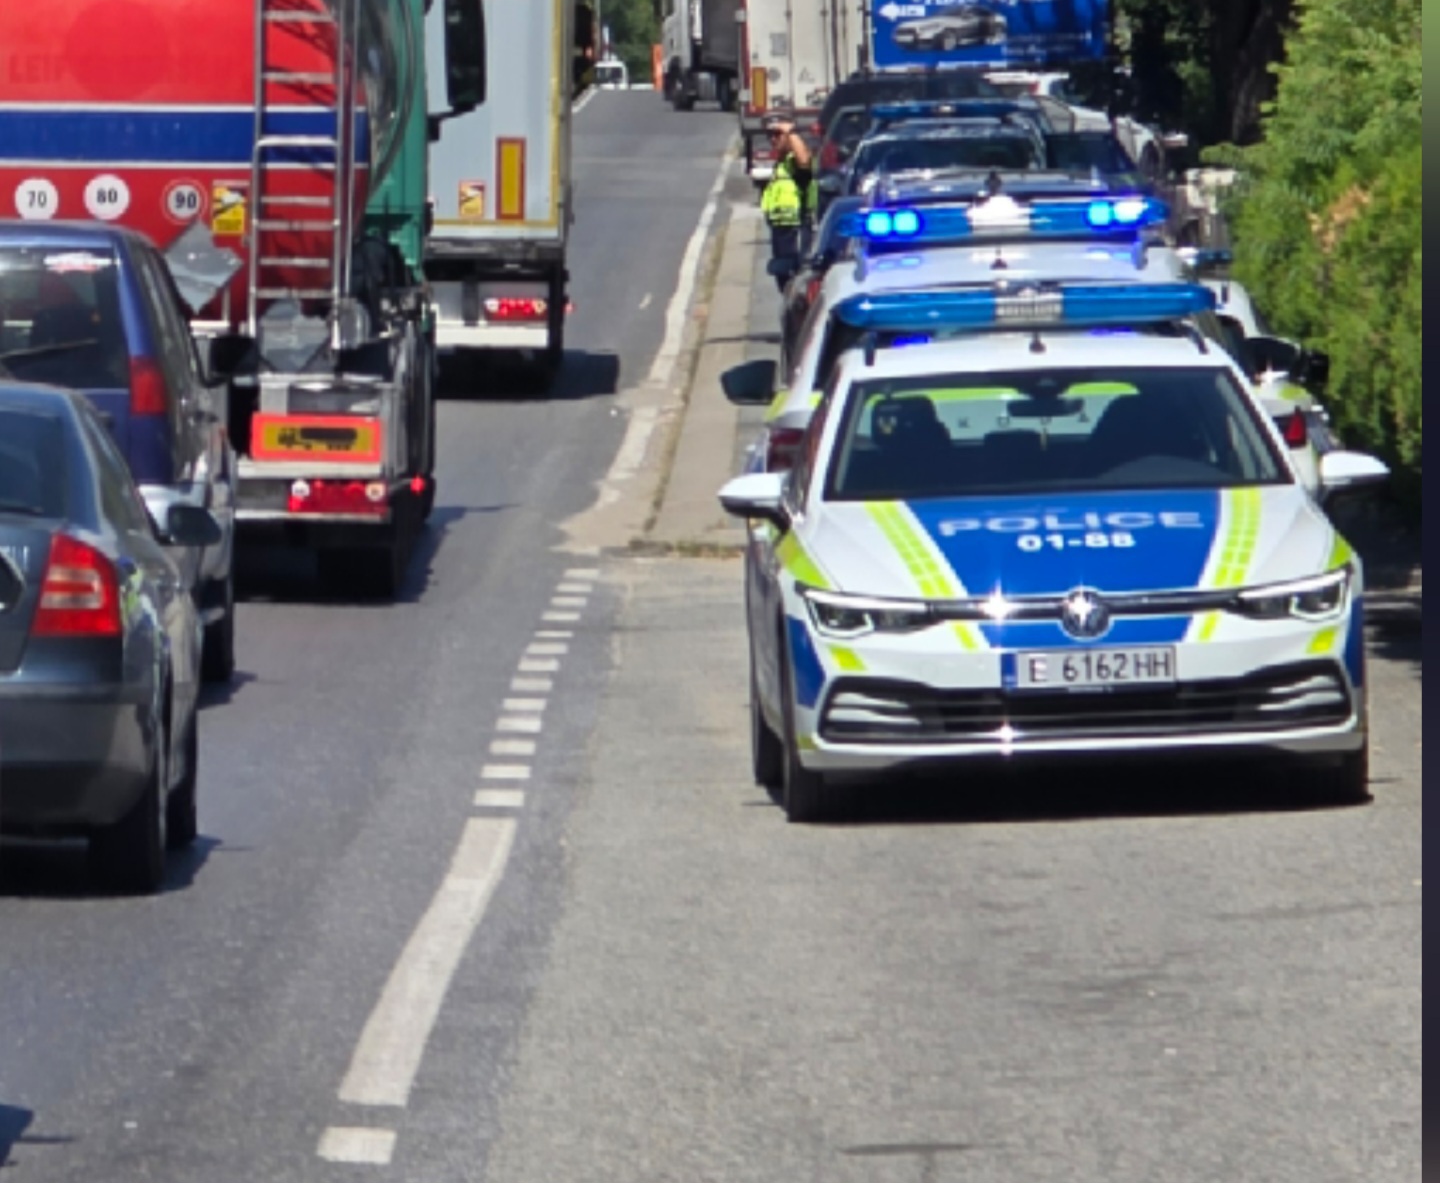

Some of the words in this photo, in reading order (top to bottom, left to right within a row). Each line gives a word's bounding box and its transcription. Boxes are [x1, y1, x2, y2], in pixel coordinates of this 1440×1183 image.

[27, 191, 47, 208] 70
[96, 188, 118, 204] 80
[175, 192, 197, 209] 90
[938, 512, 1205, 536] POLICE
[1028, 657, 1049, 683] E
[1062, 653, 1128, 682] 6162
[1134, 652, 1172, 678] HH
